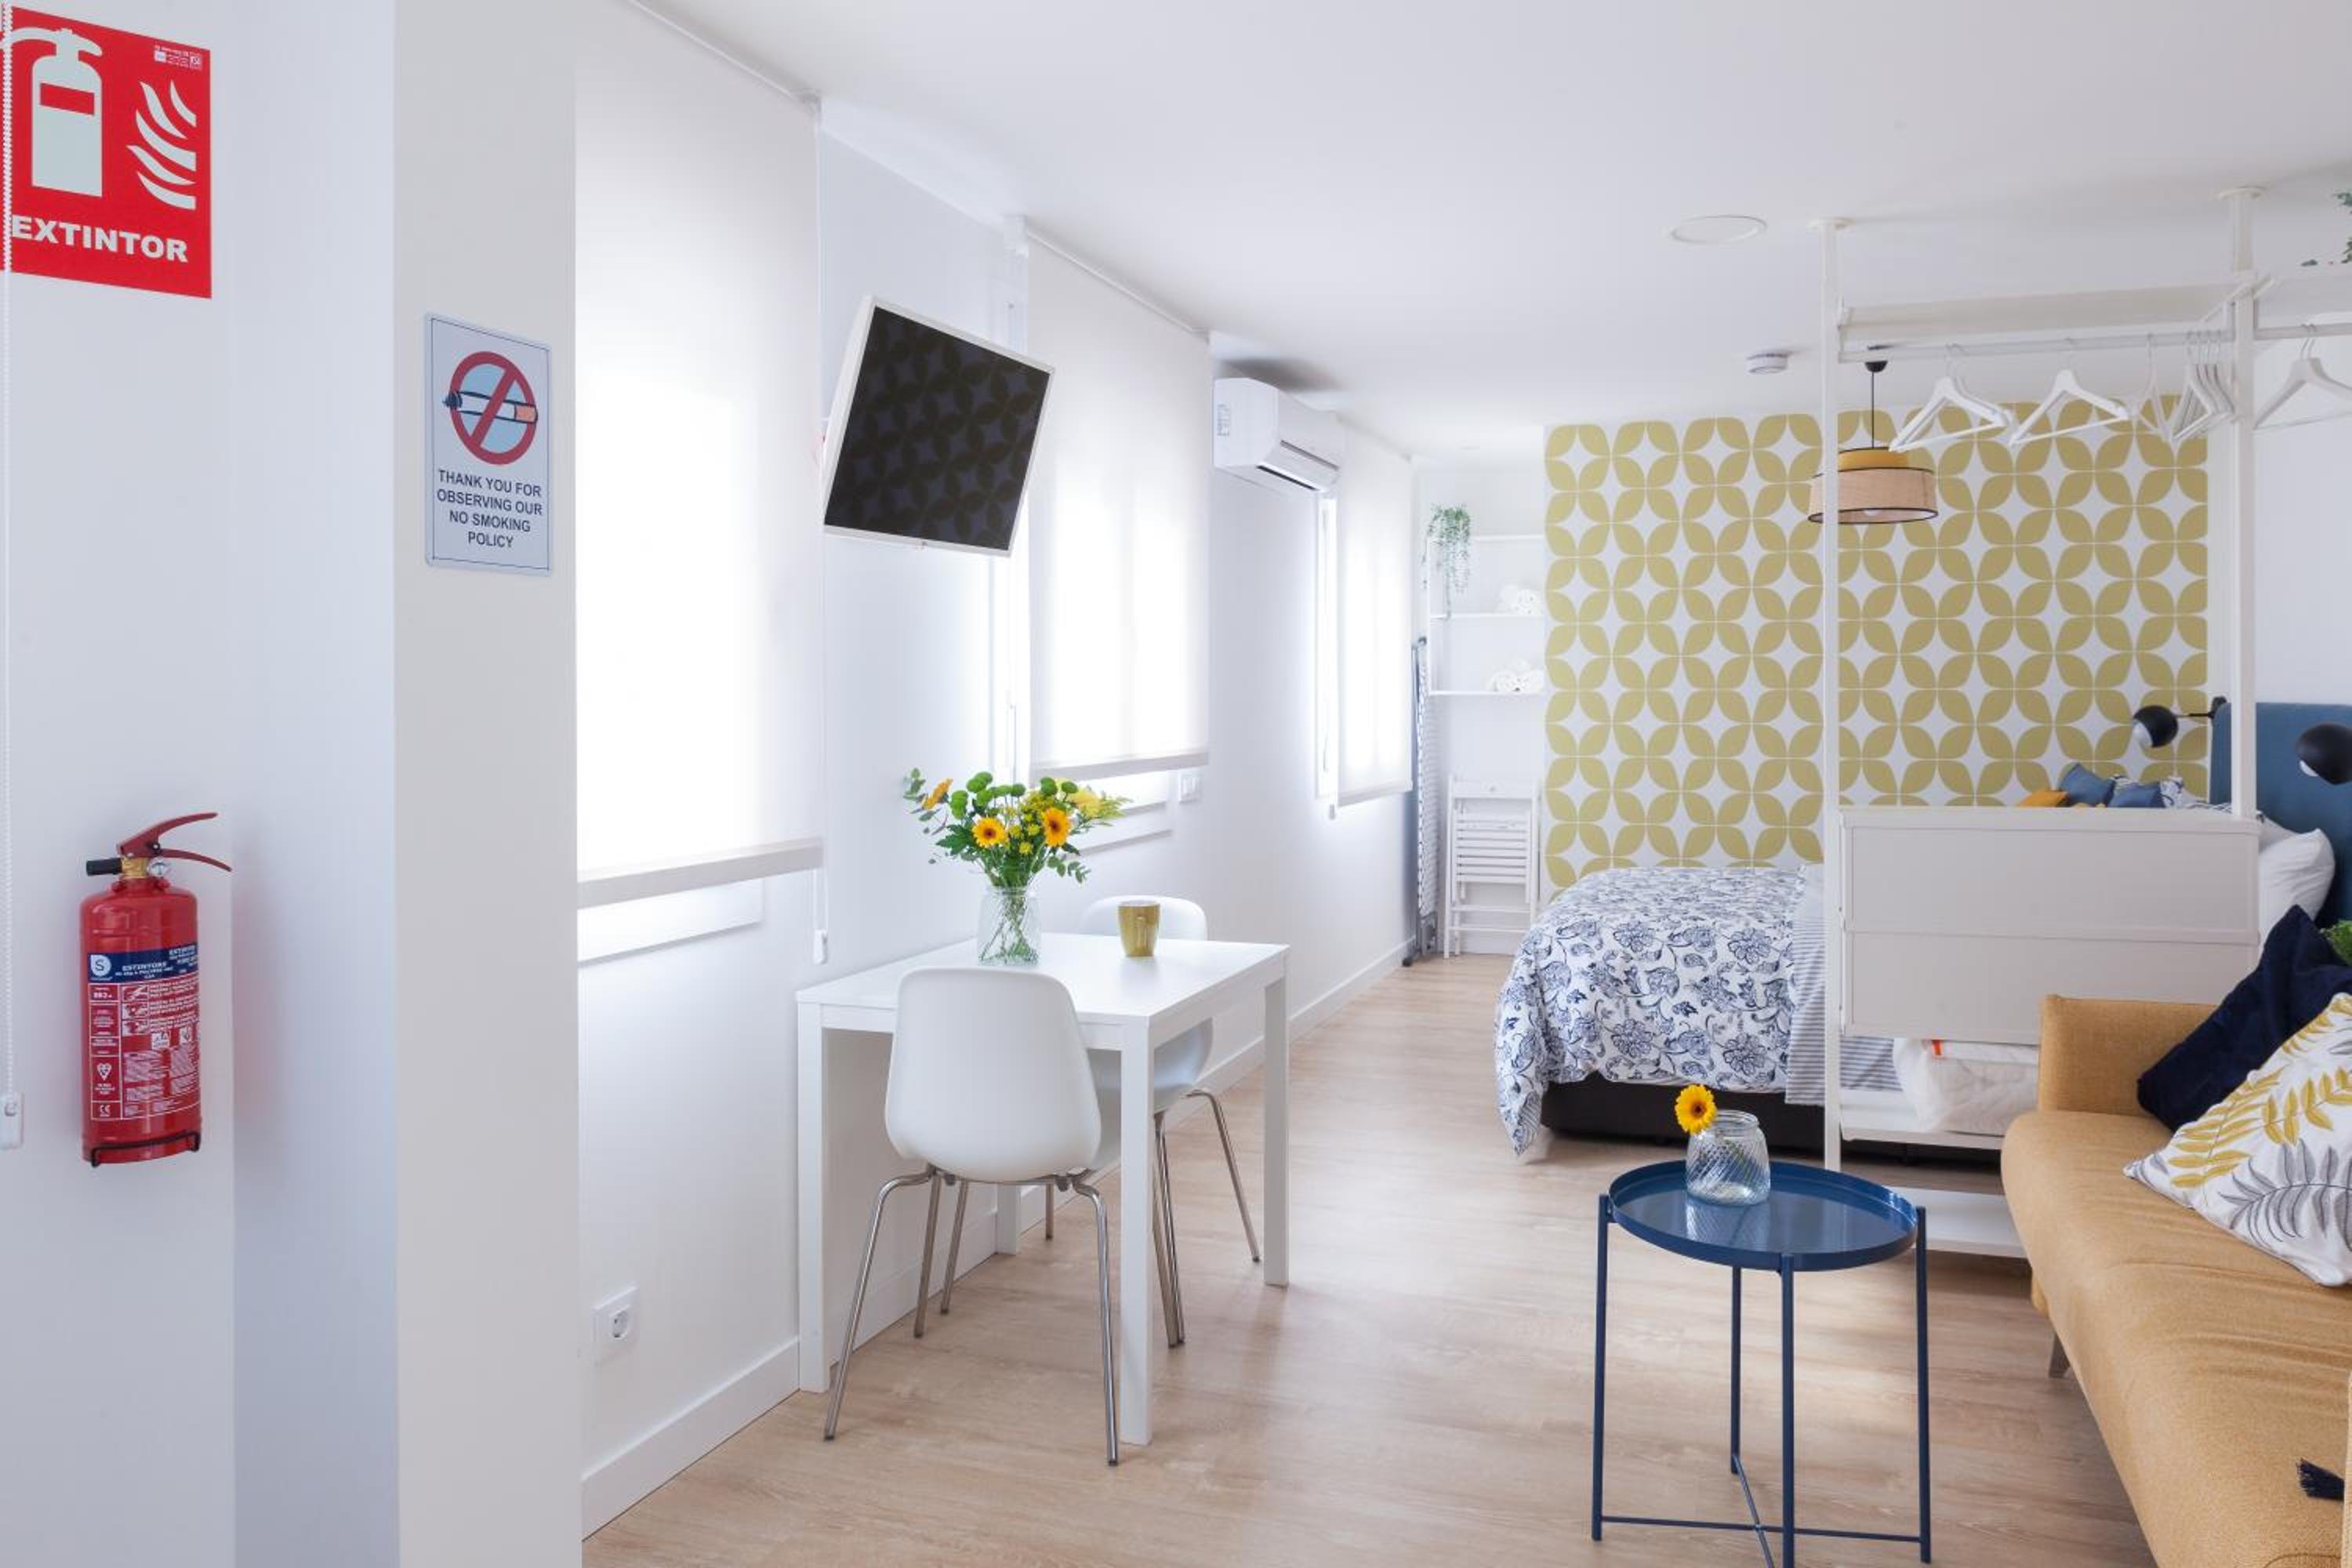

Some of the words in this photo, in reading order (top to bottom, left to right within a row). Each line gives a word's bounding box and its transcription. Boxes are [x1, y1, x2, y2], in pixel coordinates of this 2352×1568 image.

[12, 214, 188, 263] EXTINTOR
[439, 470, 482, 488] THANK
[485, 477, 512, 493] YOU
[515, 482, 542, 497] FOR
[437, 488, 512, 512] OBSERVING
[515, 501, 543, 515] OUR
[449, 510, 468, 524] NO
[471, 513, 531, 532] SMOKING
[468, 531, 514, 548] POLICY
